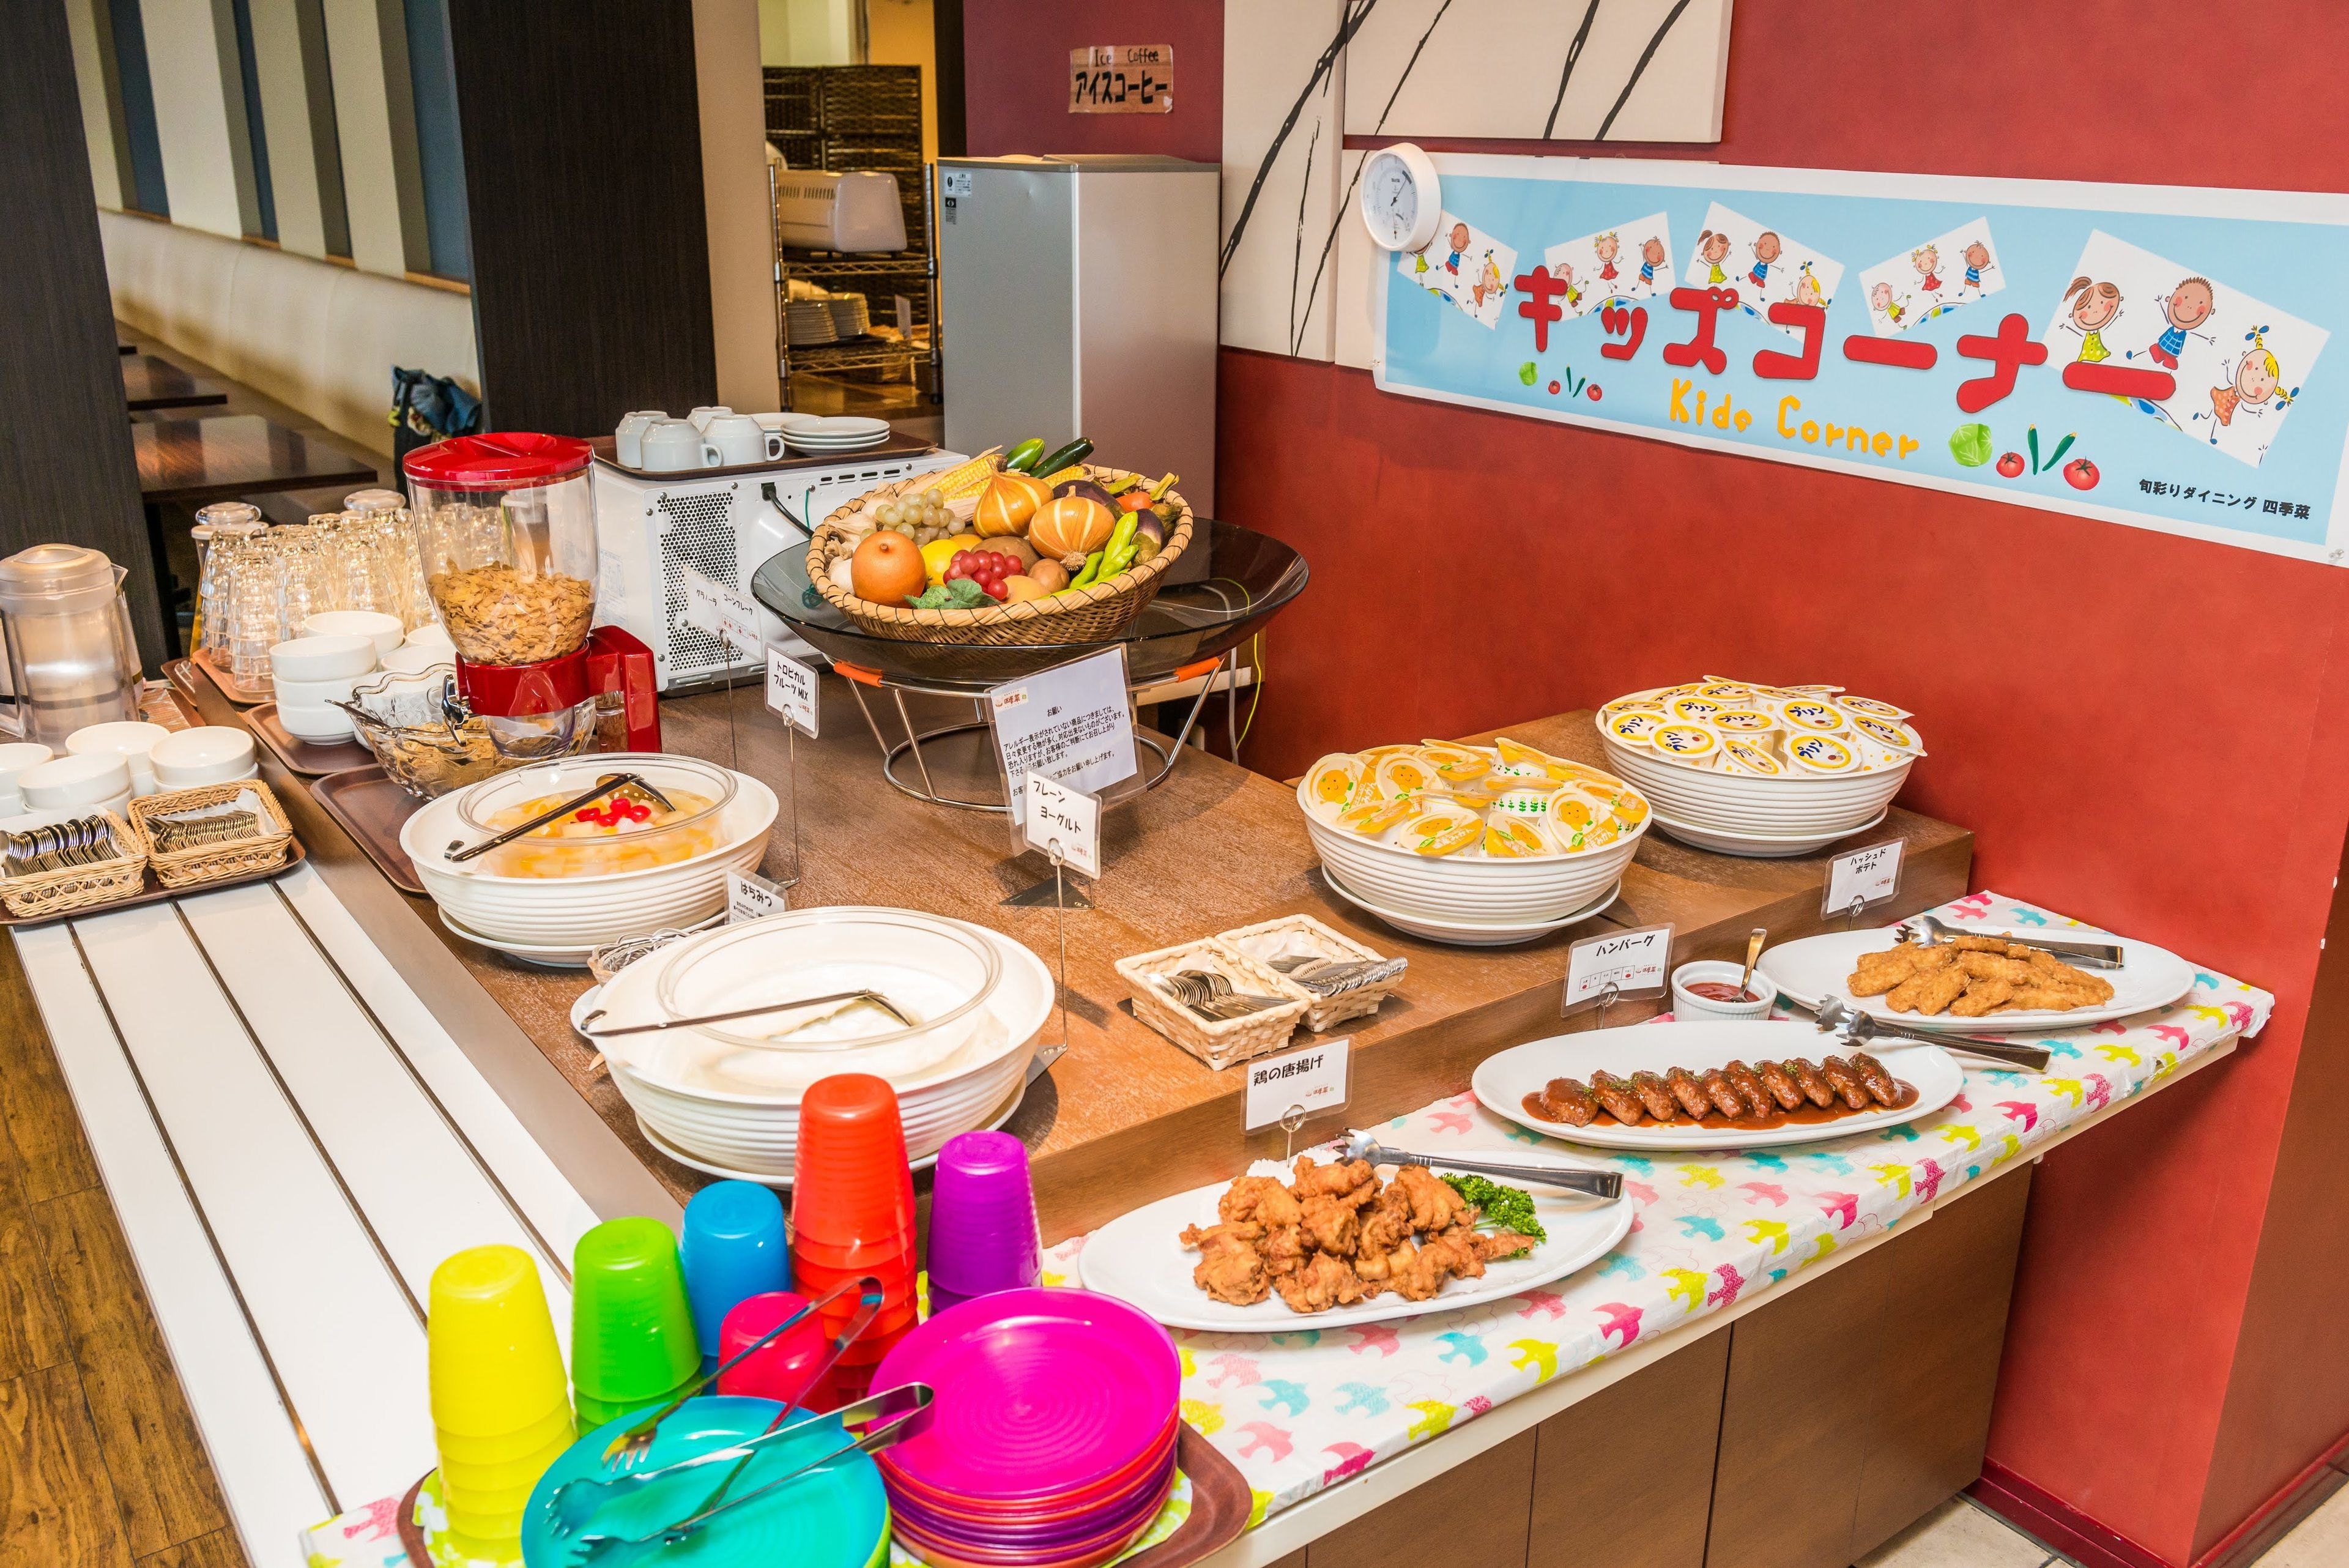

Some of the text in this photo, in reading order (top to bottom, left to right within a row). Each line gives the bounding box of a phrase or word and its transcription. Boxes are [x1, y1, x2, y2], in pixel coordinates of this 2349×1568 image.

[1094, 47, 1159, 67] Ice Coffee
[1075, 70, 1168, 105] アイスコーヒー
[1514, 264, 2176, 414] キッズコーナー
[1776, 395, 1920, 459] Corner
[2139, 478, 2311, 520] 旬彩りダイニング 四季菜
[724, 593, 753, 615] コーンフレーク
[777, 661, 806, 686] トロピカル
[774, 674, 809, 702] フルーツ MIX
[1047, 705, 1063, 718] お願い
[1680, 702, 1718, 712] プリン
[1789, 705, 1825, 717] プリン
[1620, 715, 1644, 734] プリン
[1663, 730, 1688, 751] プリン
[1797, 738, 1824, 759] プリン
[1041, 806, 1082, 834] ヨーグルト
[1850, 848, 1887, 866] ハッシュド
[1855, 861, 1877, 875] ポテト
[740, 880, 773, 907] はちみつ
[1596, 934, 1656, 957] ハンバーグ
[1253, 1054, 1324, 1087] 鶏の唐揚げ
